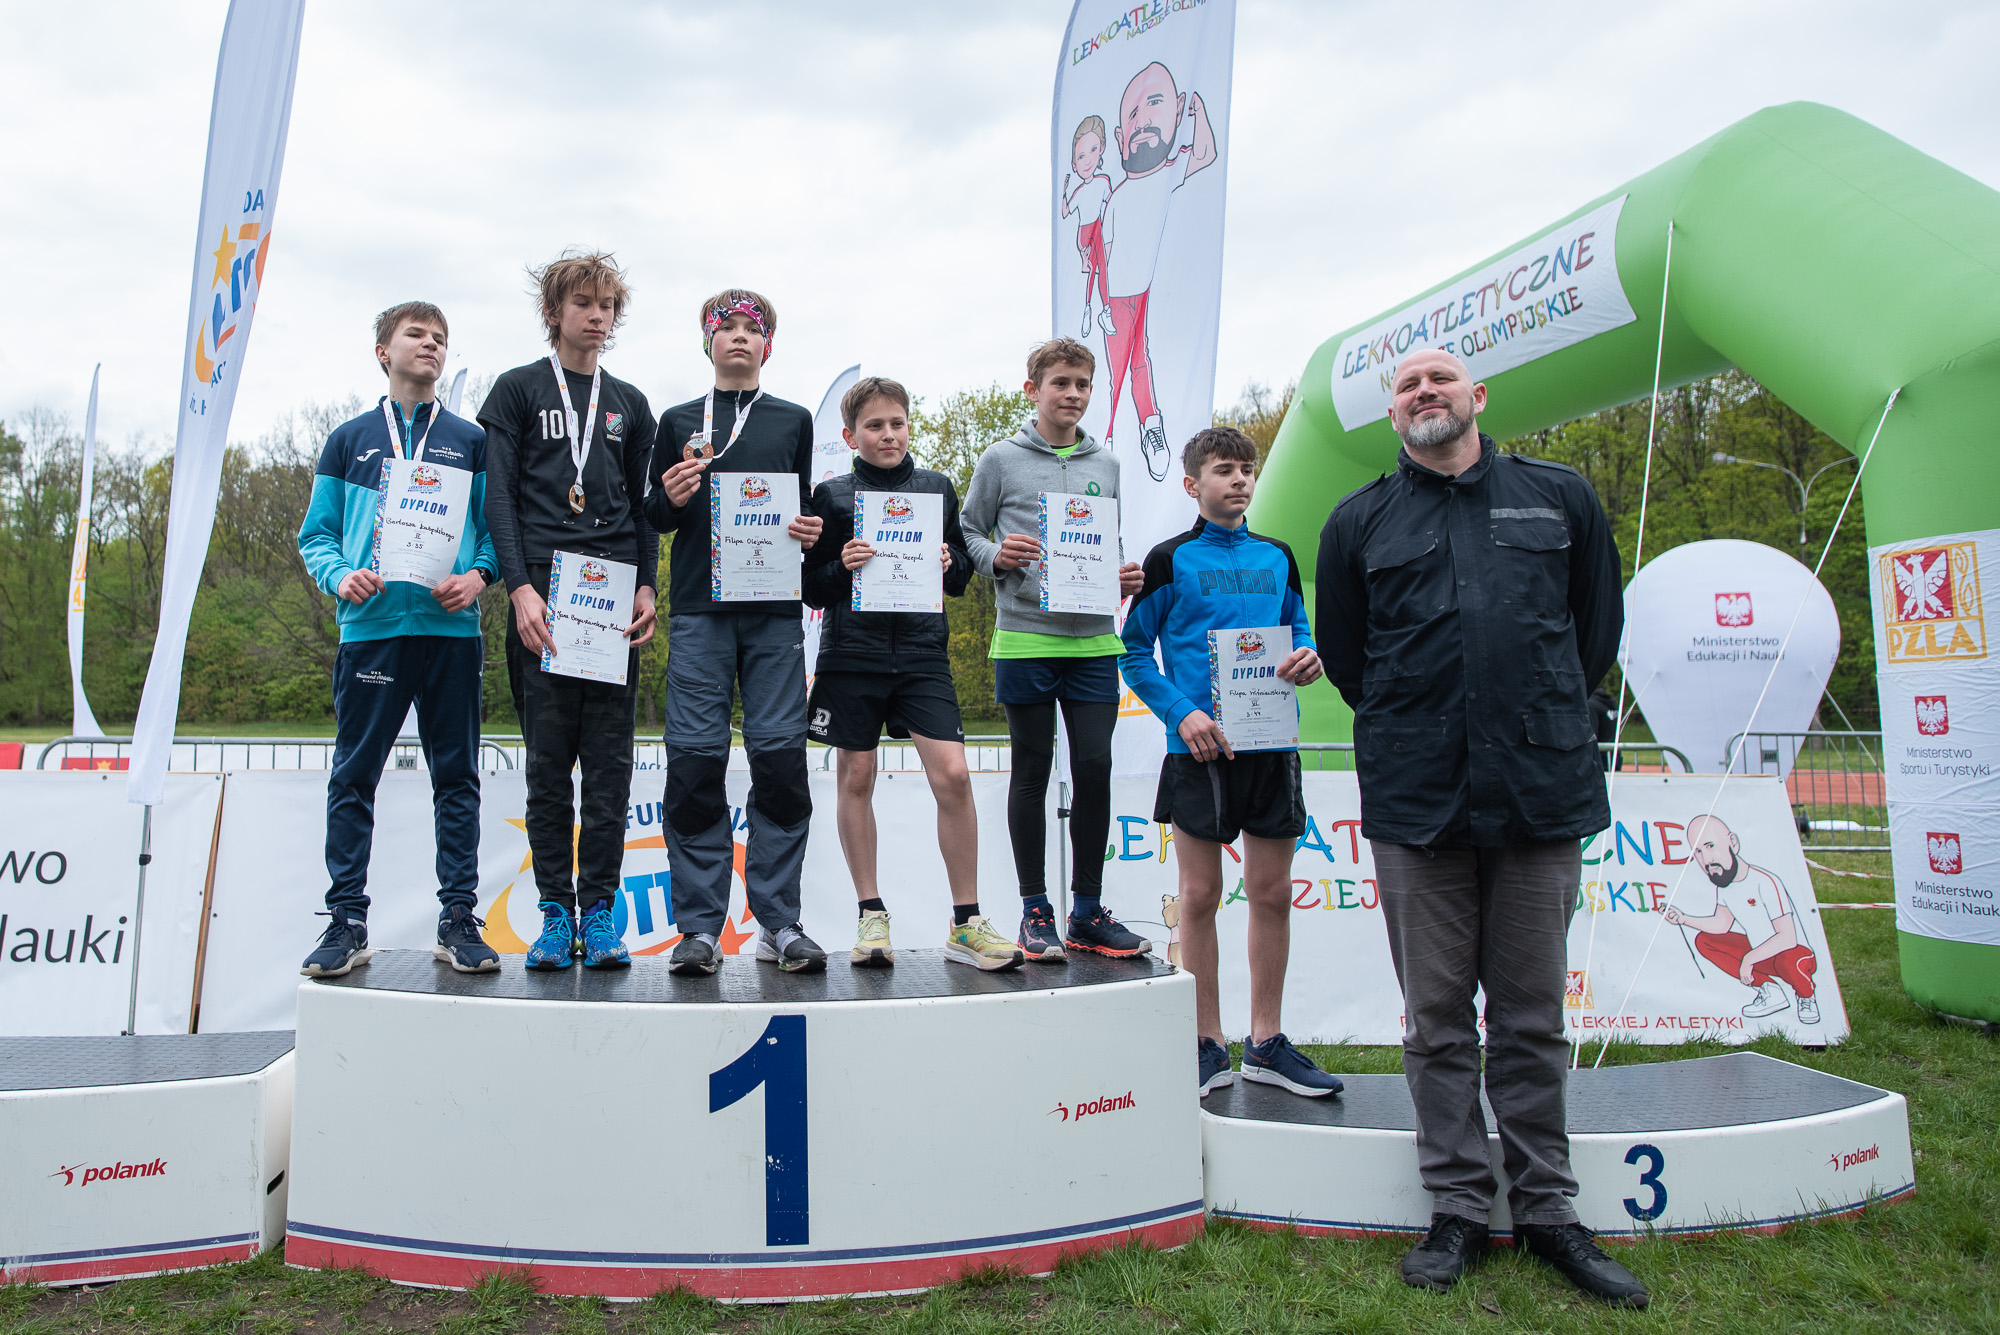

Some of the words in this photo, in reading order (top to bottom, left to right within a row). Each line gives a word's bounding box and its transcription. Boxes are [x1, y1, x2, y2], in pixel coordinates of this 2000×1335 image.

[1342, 232, 1595, 379] LEKKOATLETYCZNE
[1461, 286, 1583, 357] OLIMPIJSKIE
[400, 498, 448, 516] DYPLOM
[734, 513, 781, 526] DYPLOM
[725, 536, 744, 546] Filipa
[876, 530, 923, 543] DYPLOM
[1060, 531, 1102, 546] DYPLOM
[1197, 569, 1278, 596] PUMA
[570, 593, 615, 612] DYPLOM
[1693, 636, 1780, 647] Ministerstwo
[1687, 650, 1741, 662] Edukacji
[1749, 650, 1786, 661] Nauki
[1232, 665, 1276, 680] DYPLOM
[1907, 747, 1973, 759] Ministerstwo
[1900, 763, 1927, 776] Sportu
[1934, 763, 1991, 778] Turystyki
[1915, 880, 1993, 899] Ministerstwo
[1912, 896, 1952, 915] Edukacji
[1571, 1016, 1648, 1029] LEKKIEJ
[1655, 1016, 1744, 1029] ATLETYKI
[1074, 1090, 1136, 1122] polanik
[709, 1014, 809, 1246] 1
[1843, 1143, 1879, 1172] polanik
[81, 1157, 168, 1187] polanik
[1622, 1143, 1668, 1222] 3
